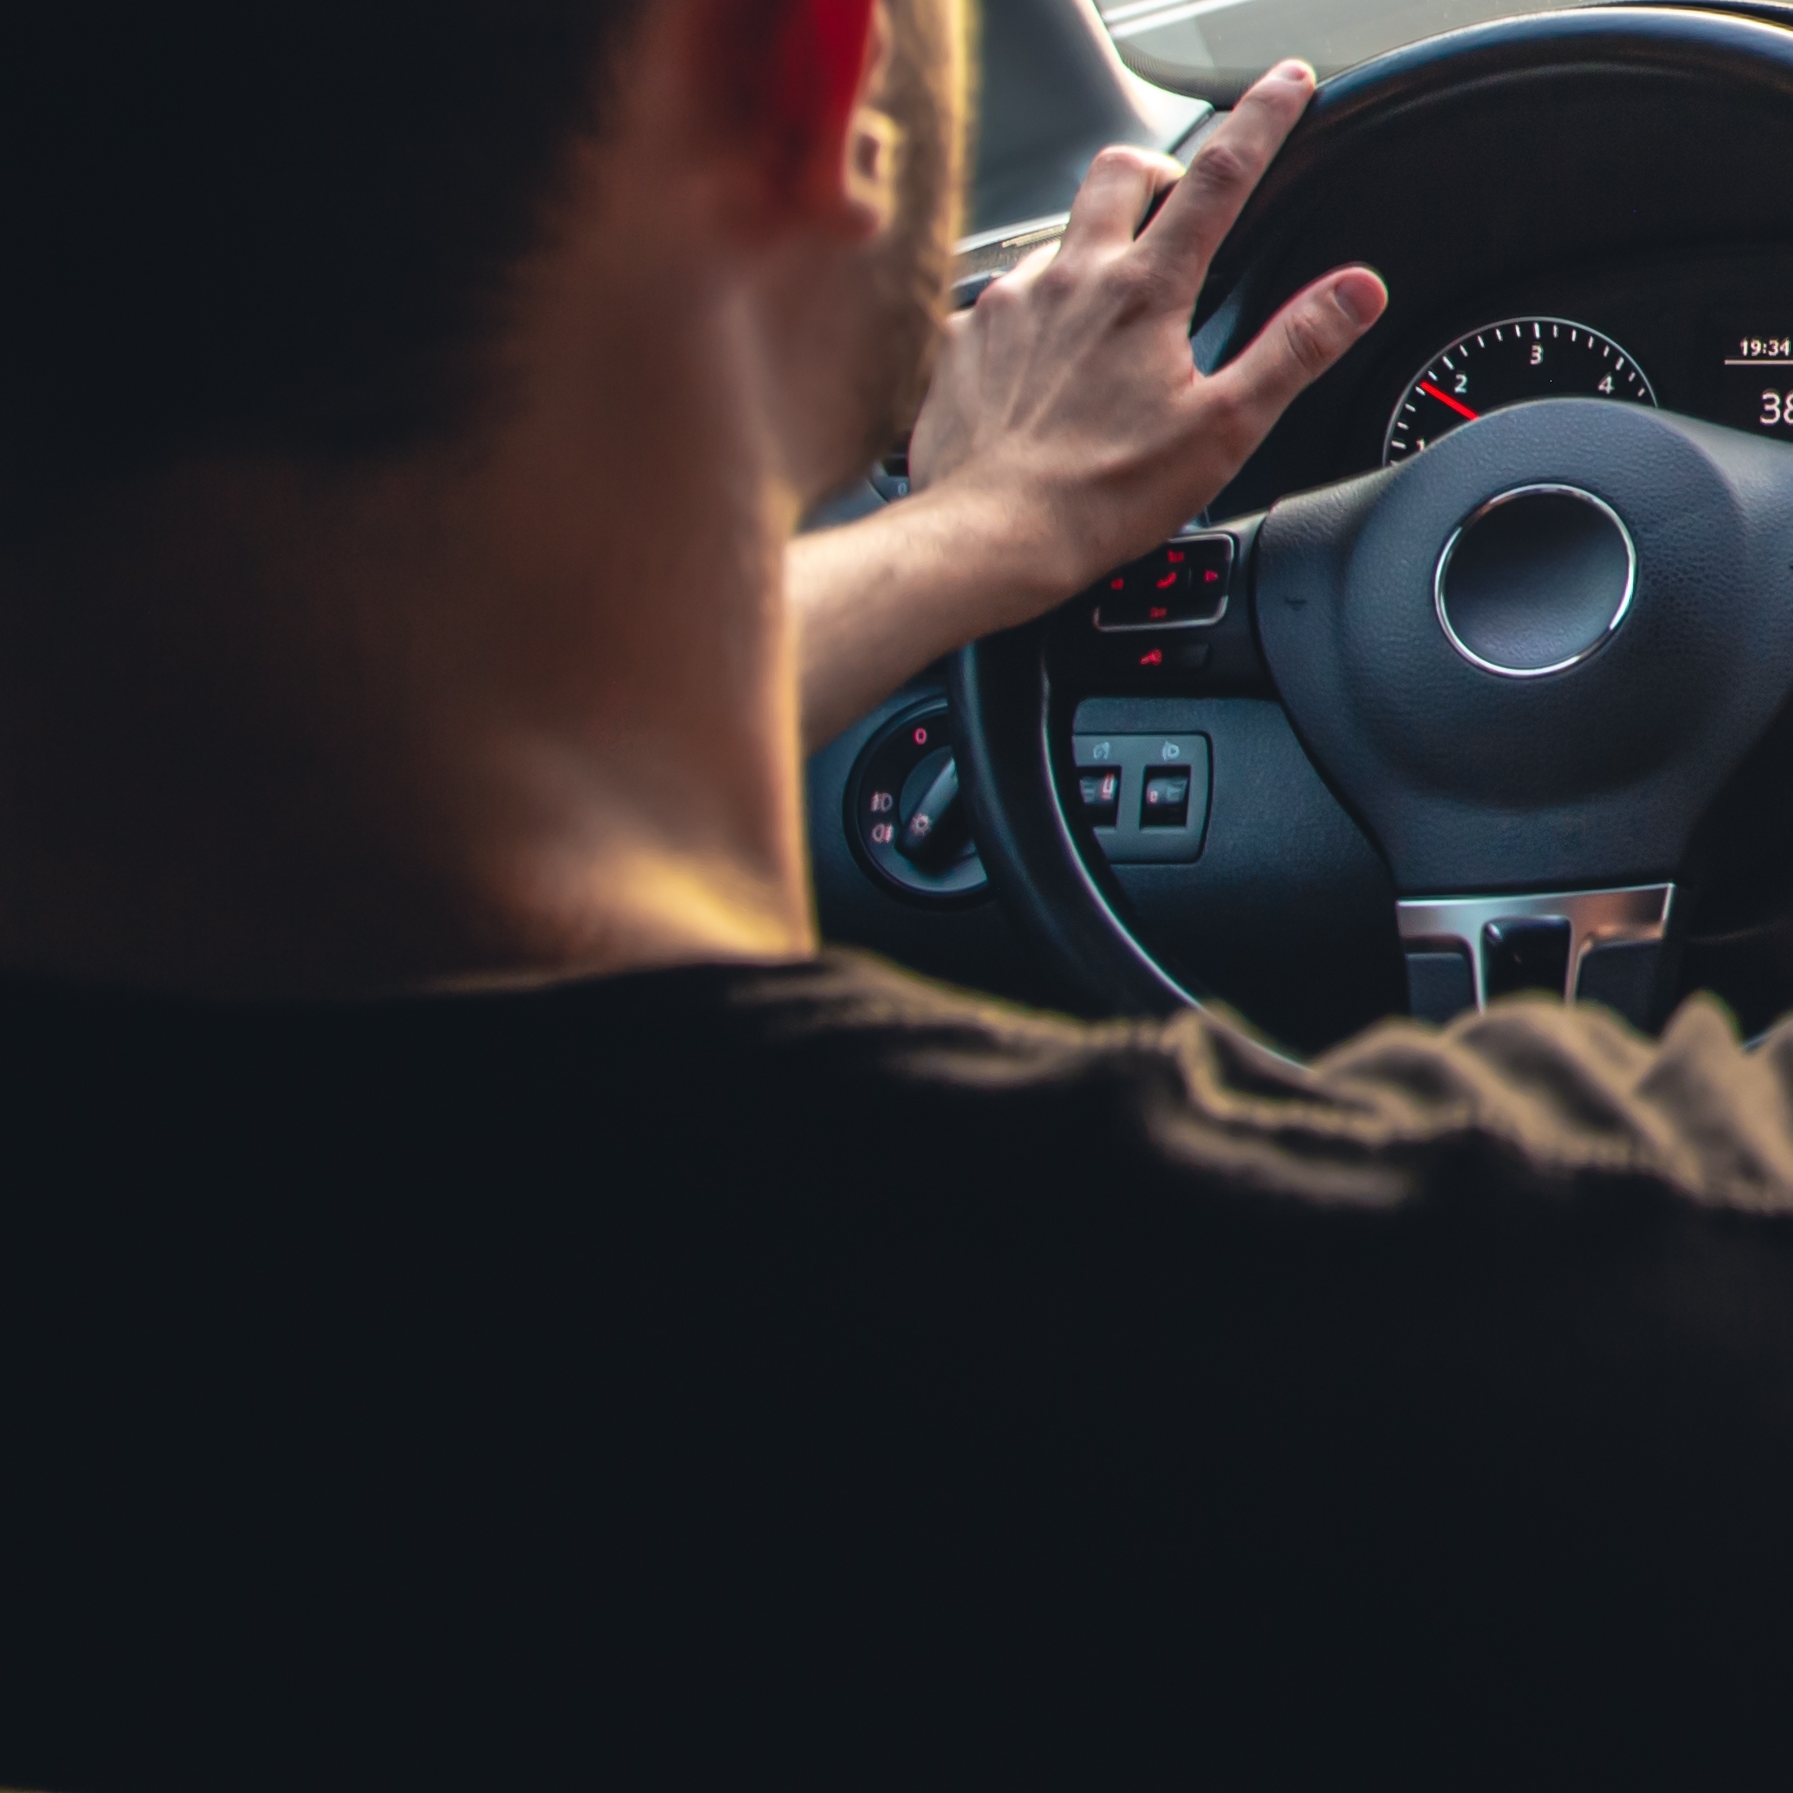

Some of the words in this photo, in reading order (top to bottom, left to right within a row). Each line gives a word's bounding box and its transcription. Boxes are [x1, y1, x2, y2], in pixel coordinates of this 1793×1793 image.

[1530, 342, 1544, 365] 3
[1740, 337, 1790, 356] 19:34
[1454, 372, 1468, 394] 2
[1598, 373, 1614, 395] 4
